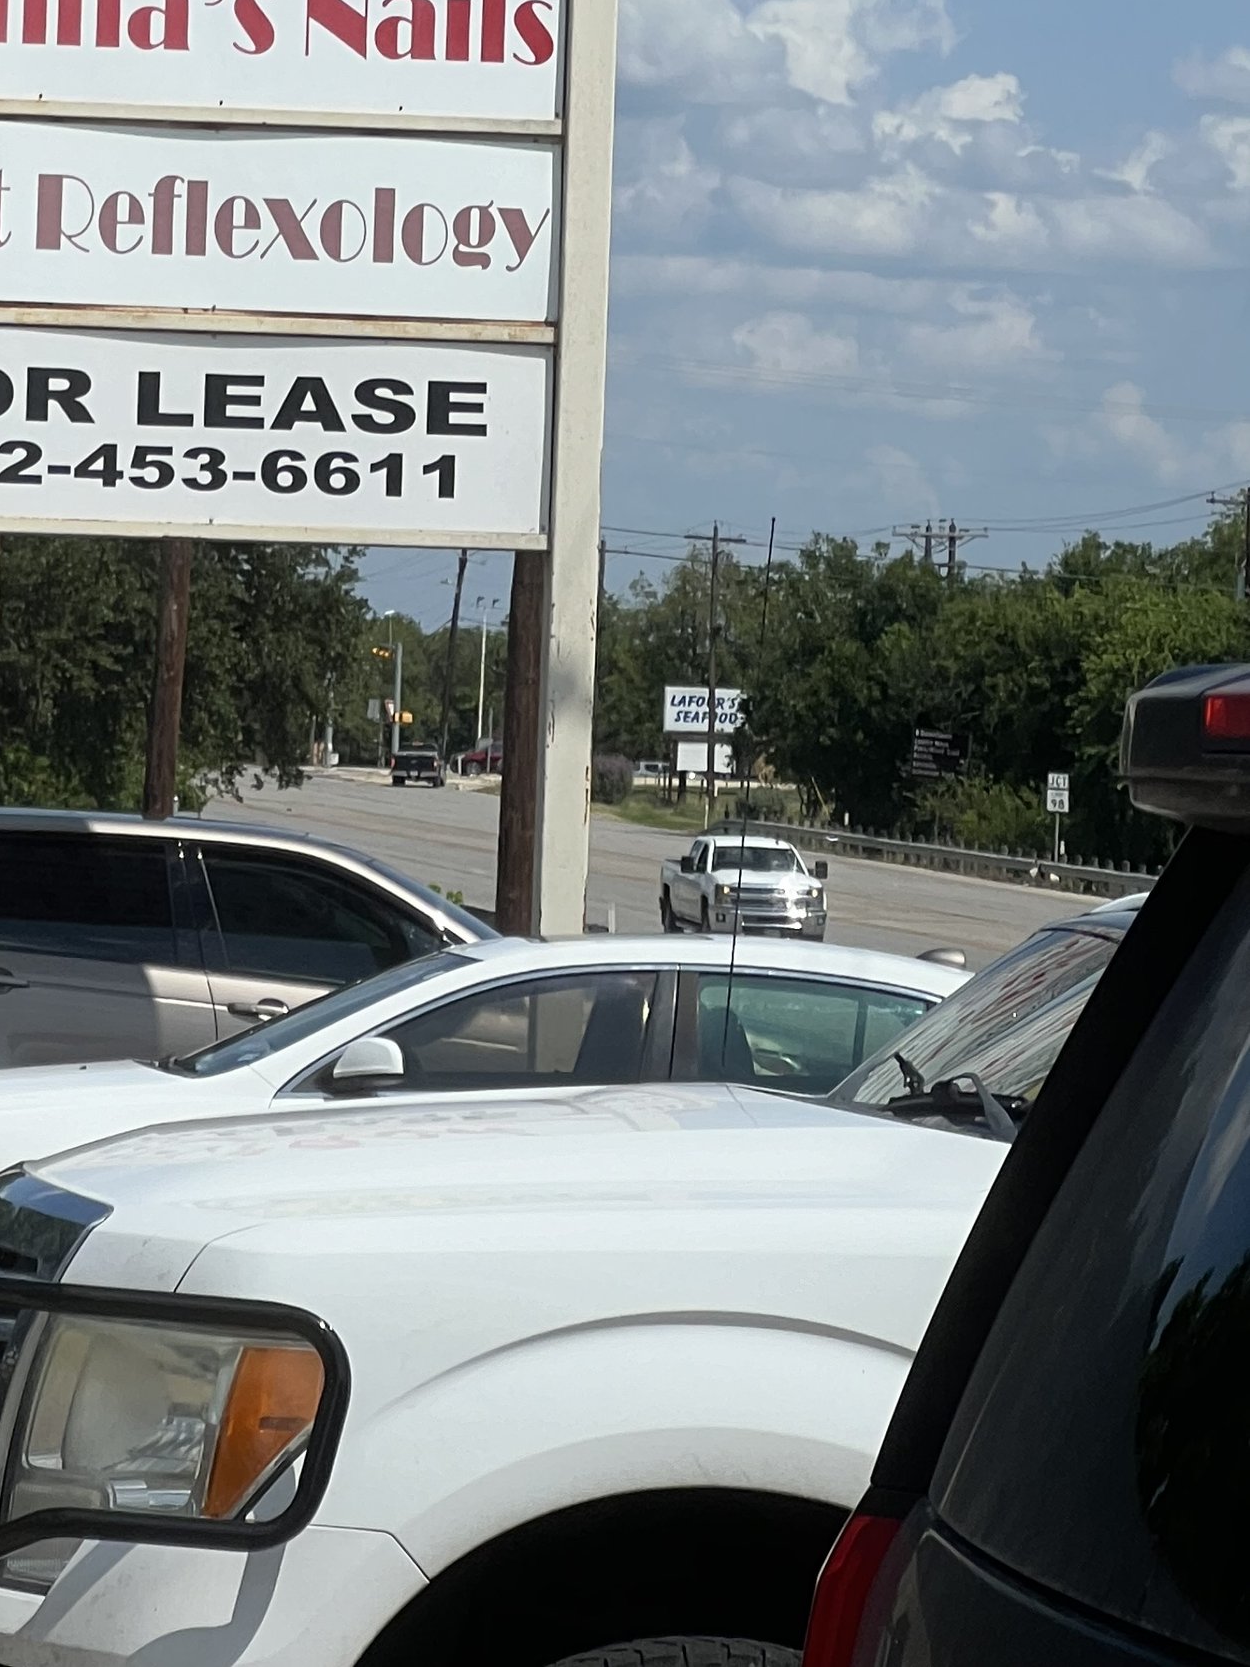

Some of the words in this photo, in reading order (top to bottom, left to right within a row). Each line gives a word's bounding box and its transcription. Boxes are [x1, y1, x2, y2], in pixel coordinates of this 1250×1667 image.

[35, 173, 551, 272] Reflexology
[136, 370, 488, 437] LEASE
[674, 710, 738, 724] SEAFOD
